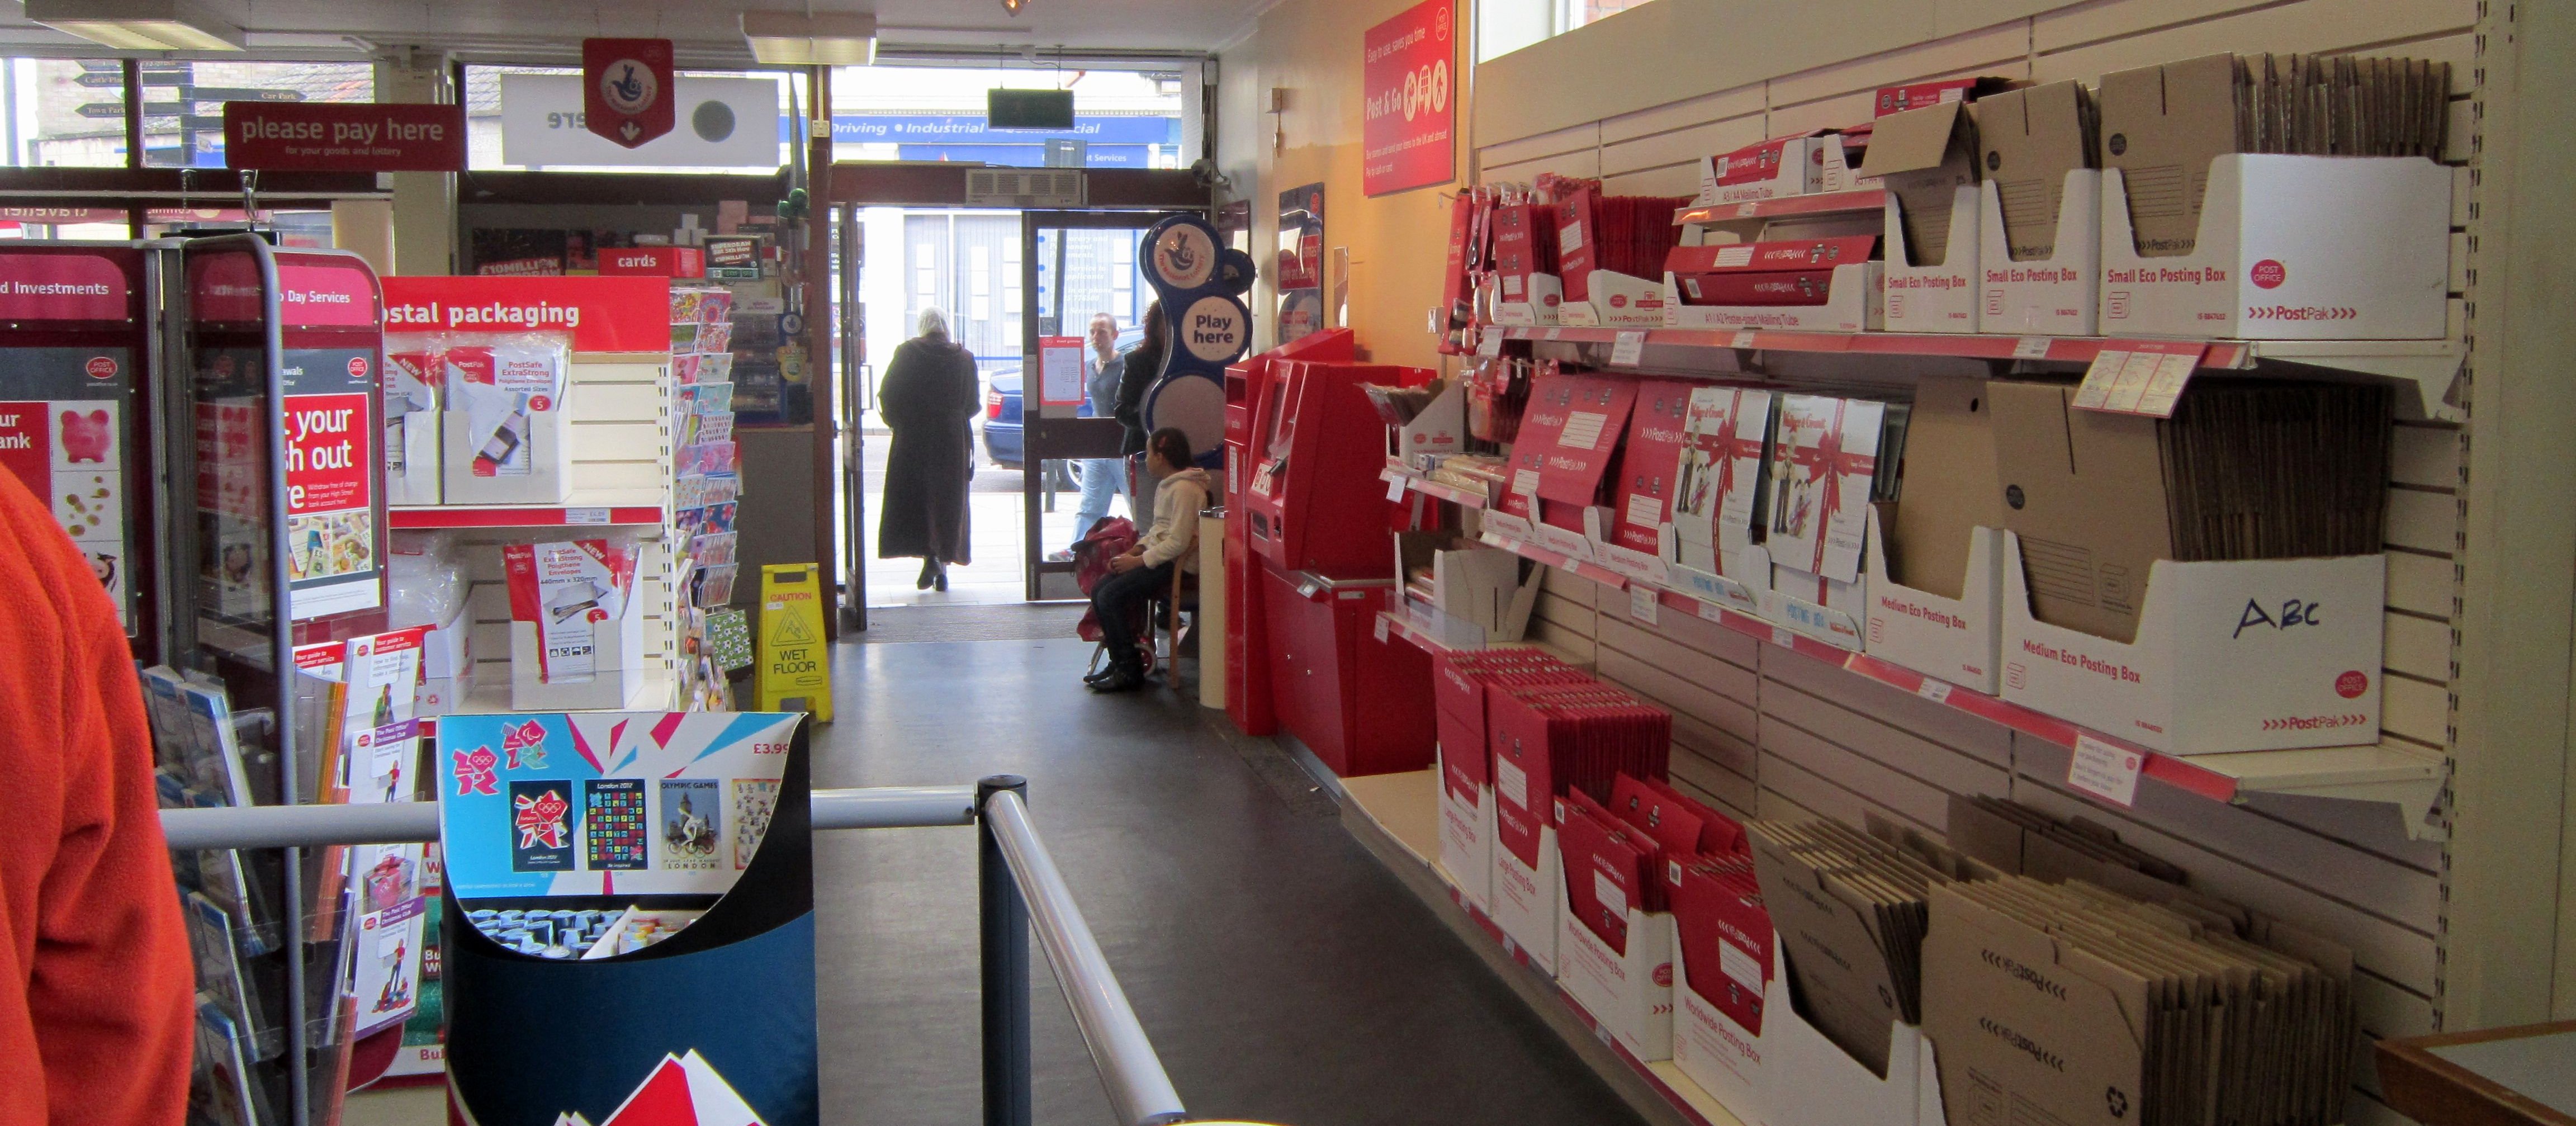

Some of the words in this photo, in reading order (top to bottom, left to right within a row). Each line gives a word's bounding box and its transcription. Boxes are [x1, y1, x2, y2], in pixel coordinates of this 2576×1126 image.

[1367, 96, 1382, 120] Post
[1384, 91, 1390, 115] &
[1392, 87, 1401, 112] Go
[242, 116, 323, 143] please
[333, 121, 377, 144] pay
[387, 118, 443, 141] here
[906, 122, 985, 134] Industrial
[286, 146, 297, 154] for
[301, 148, 320, 156] your
[324, 146, 350, 156] goods
[353, 146, 369, 155] and
[372, 146, 401, 156] lottery
[1759, 187, 1773, 198] Tube
[618, 255, 657, 268] cards
[1986, 269, 2009, 283] Small
[2011, 268, 2024, 282] Eco
[2027, 268, 2058, 284] Posting
[2061, 268, 2077, 281] Box
[2108, 269, 2136, 283] Small
[2139, 268, 2156, 282] Eco
[2160, 267, 2201, 285] Posting
[2205, 267, 2226, 282] Box
[2258, 266, 2278, 274] POST
[1888, 277, 1908, 289] Small
[1909, 276, 1921, 288] Eco
[1922, 275, 1950, 290] Posting
[1952, 275, 1967, 287] Box
[2254, 274, 2282, 282] OFFICE
[15, 281, 110, 295] Investments
[288, 292, 307, 304] Day
[309, 290, 351, 303] Services
[382, 302, 439, 323] ostal
[449, 302, 580, 327] packaging
[1783, 315, 1800, 326] Tube
[1195, 315, 1232, 330] Play
[1194, 330, 1234, 344] here
[399, 358, 422, 377] NEW
[502, 369, 550, 378] ExtraStrong
[296, 408, 353, 442] your
[312, 439, 353, 469] out
[583, 542, 605, 560] NEW
[770, 592, 812, 602] CAUTION
[1882, 596, 1907, 615] Medium
[1909, 604, 1921, 618] Eco
[1923, 607, 1950, 628] Posting
[1952, 616, 1966, 631] Box
[2233, 597, 2321, 638] ABC
[780, 649, 808, 661] WET
[2023, 639, 2058, 661] Medium
[2061, 649, 2077, 666] Eco
[2080, 654, 2119, 681] Posting
[2121, 665, 2142, 684] Box
[773, 661, 816, 674] FLOOR
[2342, 675, 2361, 684] POST
[2338, 683, 2365, 692] OFFICE
[1684, 995, 1717, 1032] Worldwide
[1717, 1022, 1745, 1058] Posting
[1745, 1042, 1761, 1063] Box
